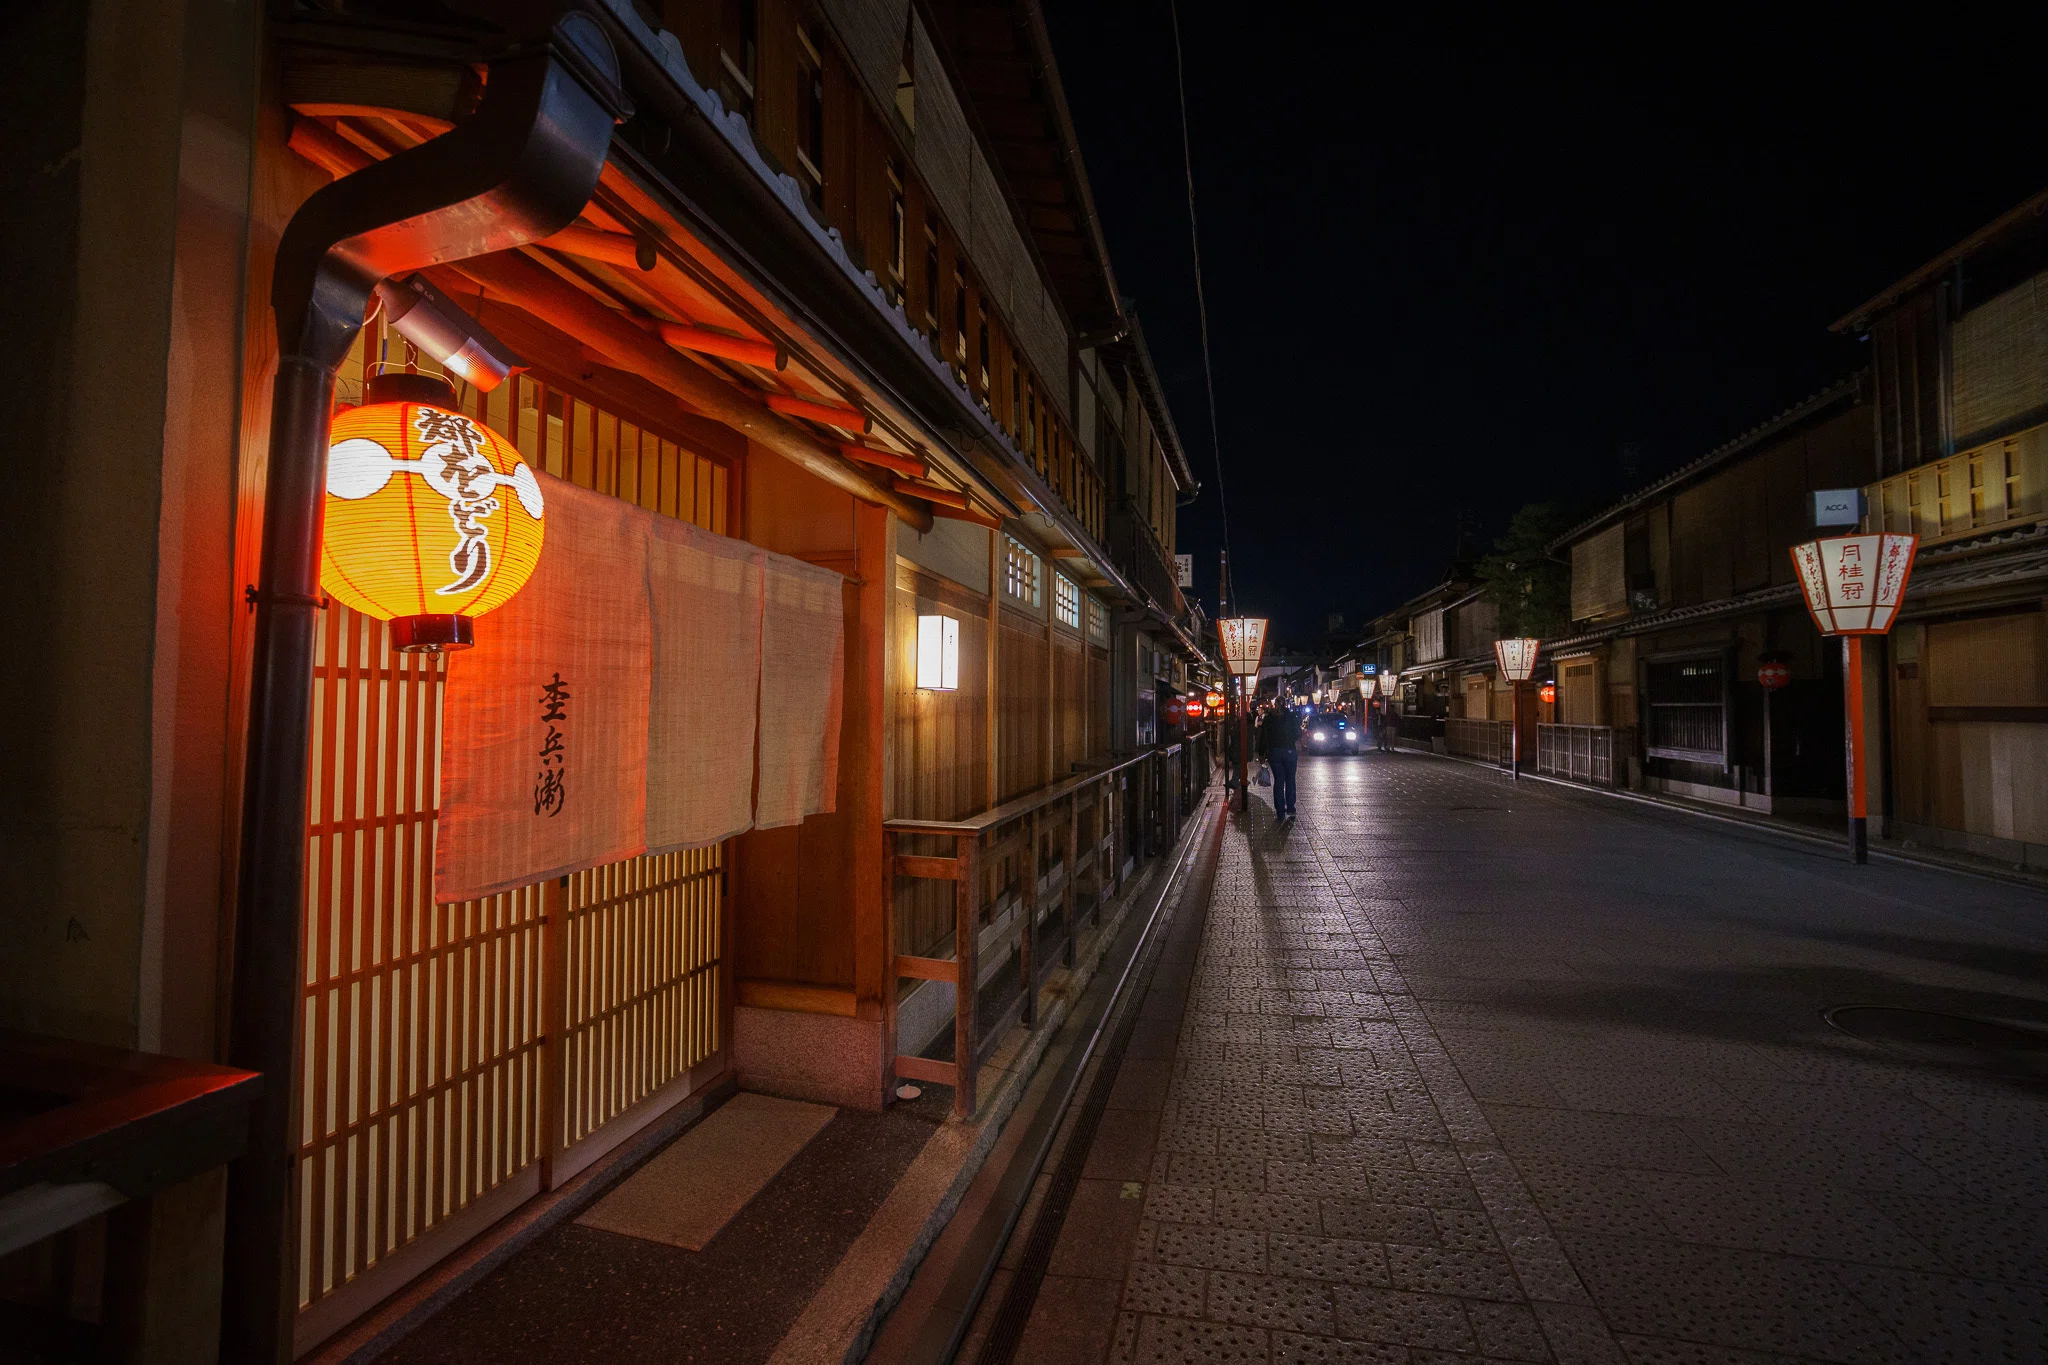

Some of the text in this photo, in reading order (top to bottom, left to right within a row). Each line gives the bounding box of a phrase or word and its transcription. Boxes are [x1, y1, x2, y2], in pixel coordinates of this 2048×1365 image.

[416, 407, 498, 594] 都をどり
[1839, 545, 1864, 600] 月桂冠
